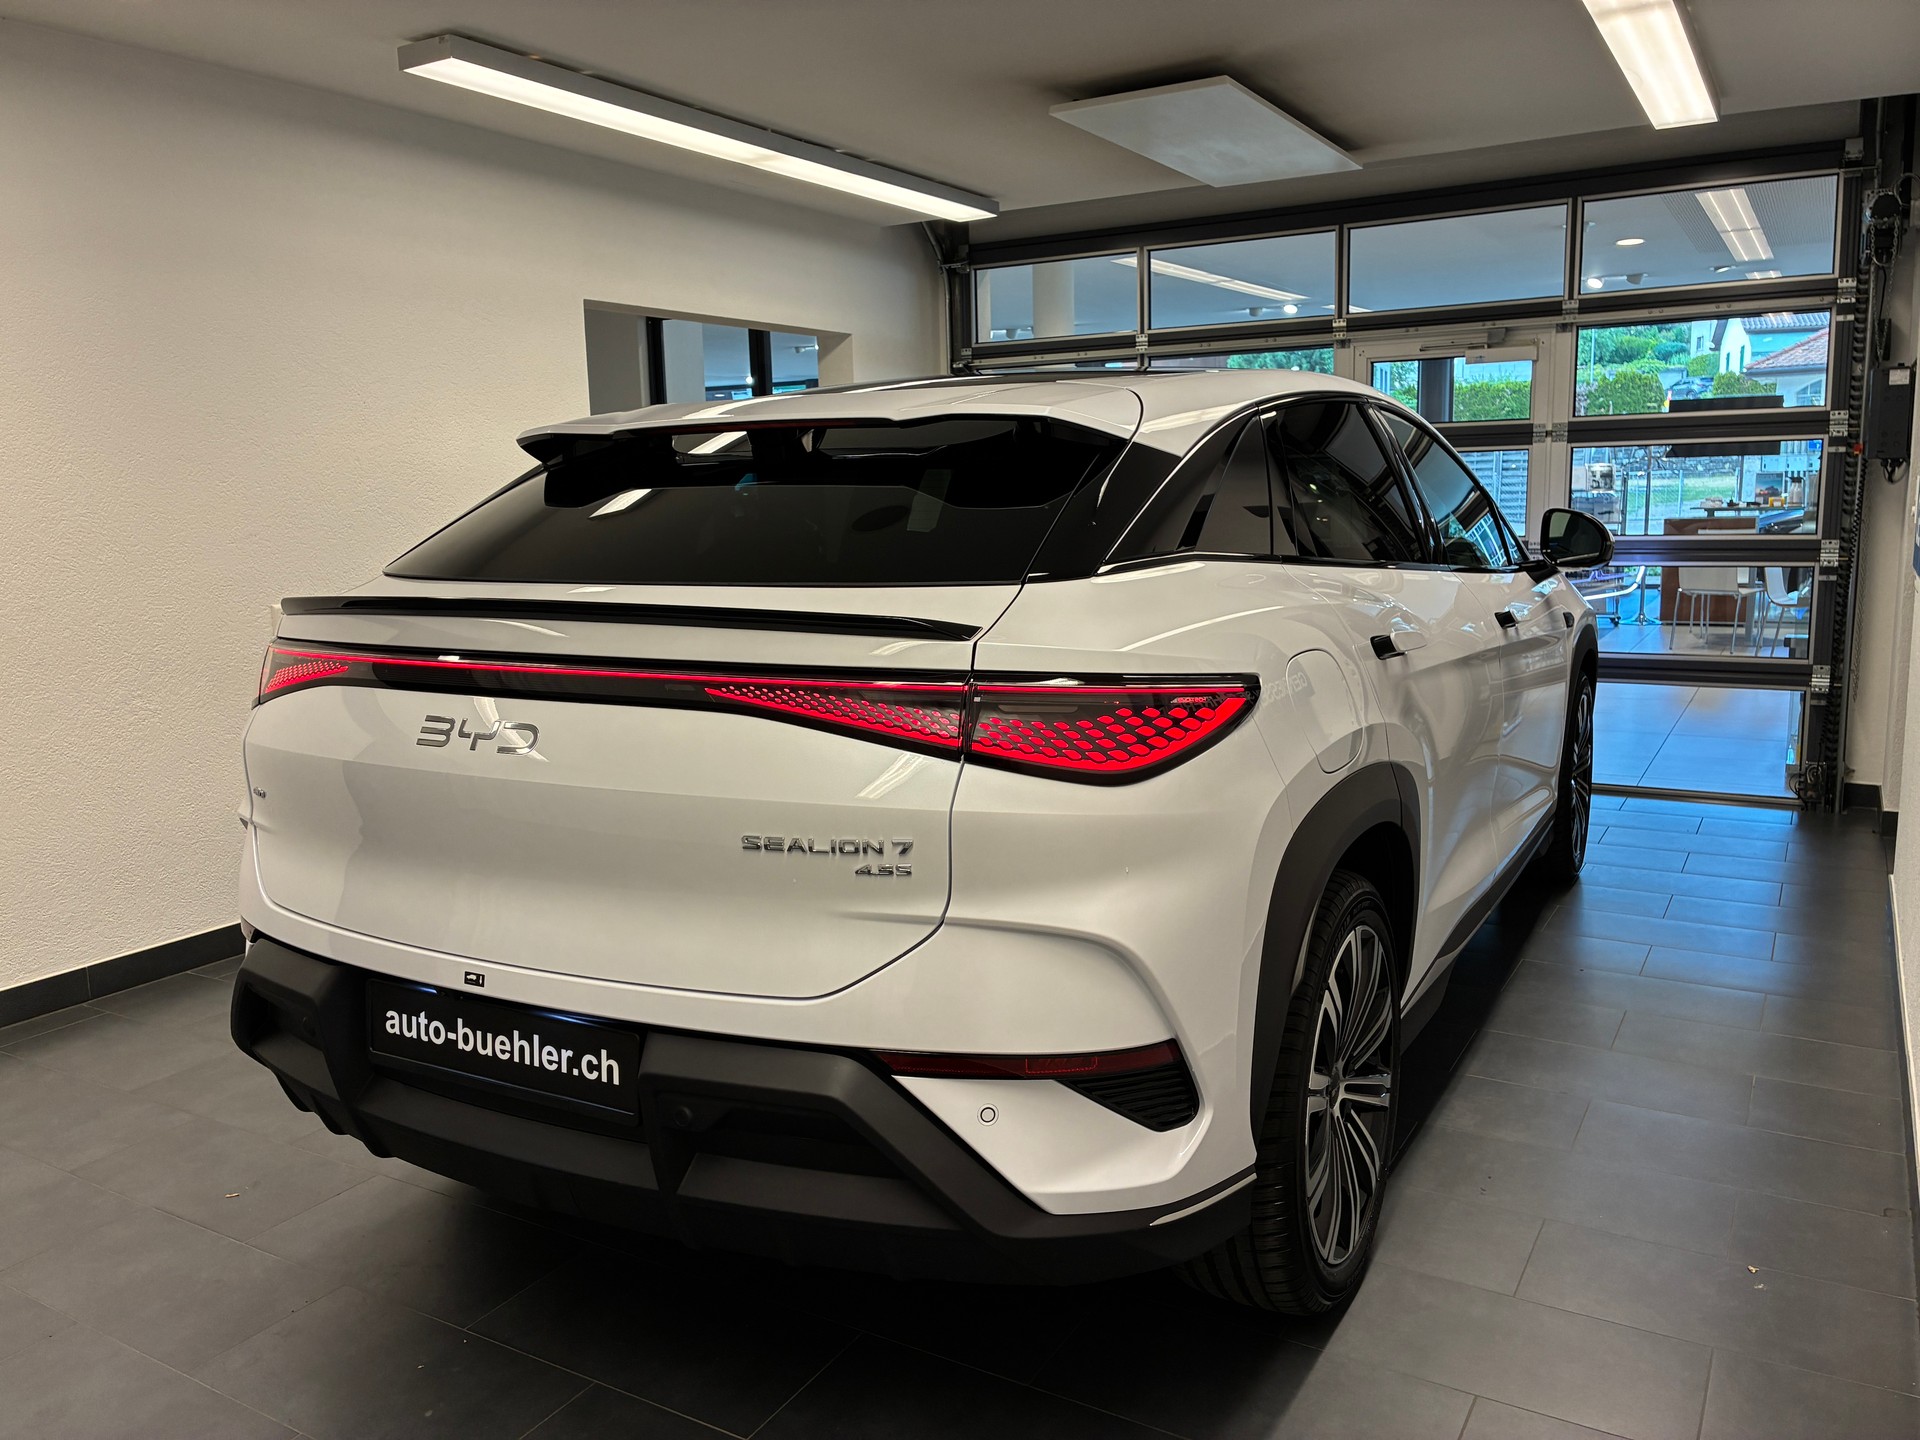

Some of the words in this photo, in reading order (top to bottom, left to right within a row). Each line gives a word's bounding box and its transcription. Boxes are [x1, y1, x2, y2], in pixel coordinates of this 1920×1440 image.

[416, 714, 540, 755] BYD
[741, 835, 885, 855] SEALION
[891, 838, 914, 855] 7
[385, 1009, 620, 1086] auto-buehler.ch
